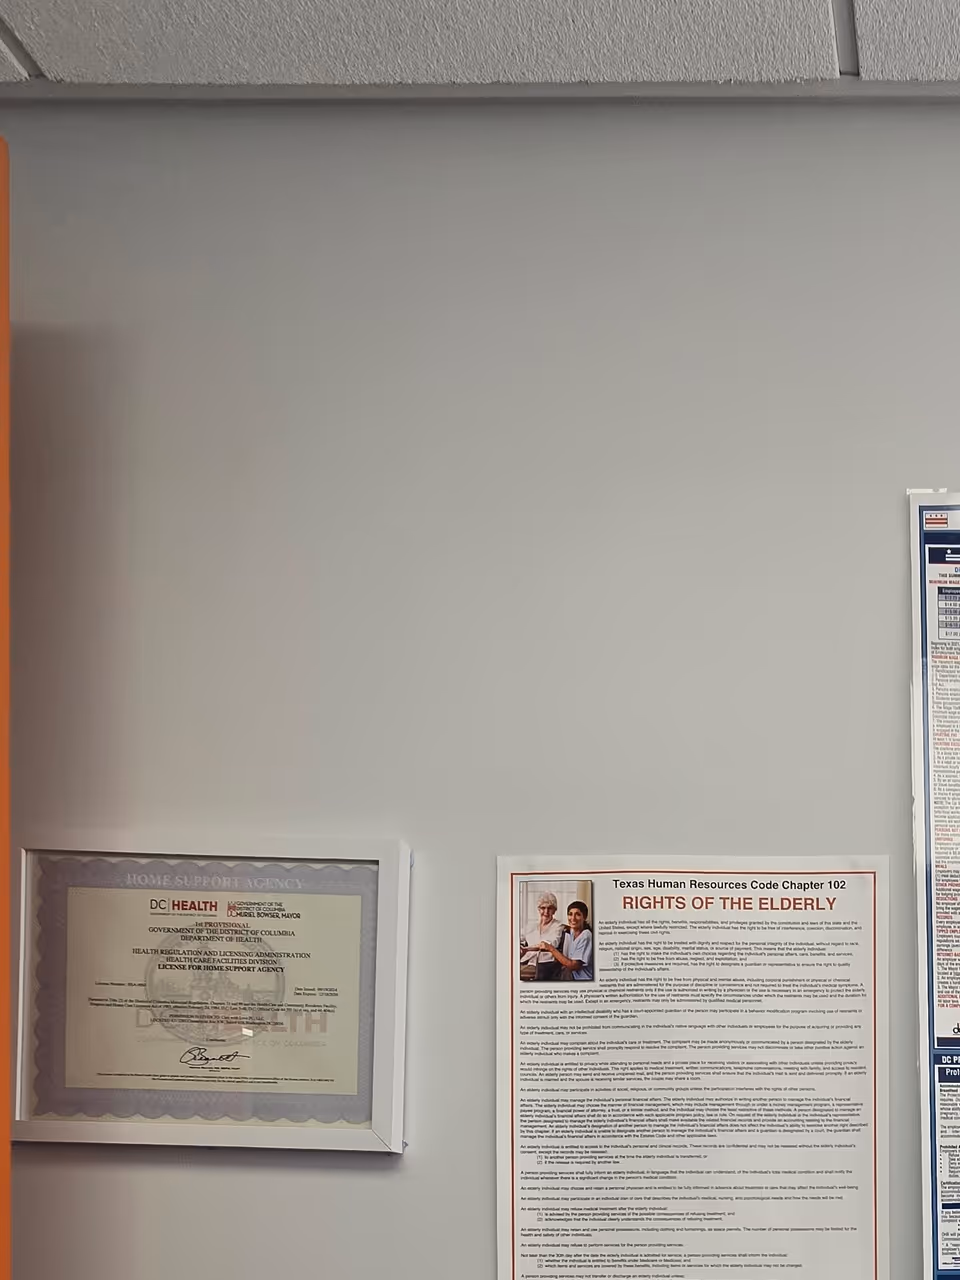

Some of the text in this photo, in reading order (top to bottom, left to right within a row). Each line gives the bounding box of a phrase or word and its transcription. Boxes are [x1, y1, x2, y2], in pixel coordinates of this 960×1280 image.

[126, 874, 305, 889] HOME SUPPORT AGENCY
[612, 879, 846, 890] Texas Human Resources Code Chapter 102
[150, 898, 167, 909] DC
[172, 900, 217, 911] HEALTH
[623, 896, 836, 910] RIGHTS OF THE ELDERLY
